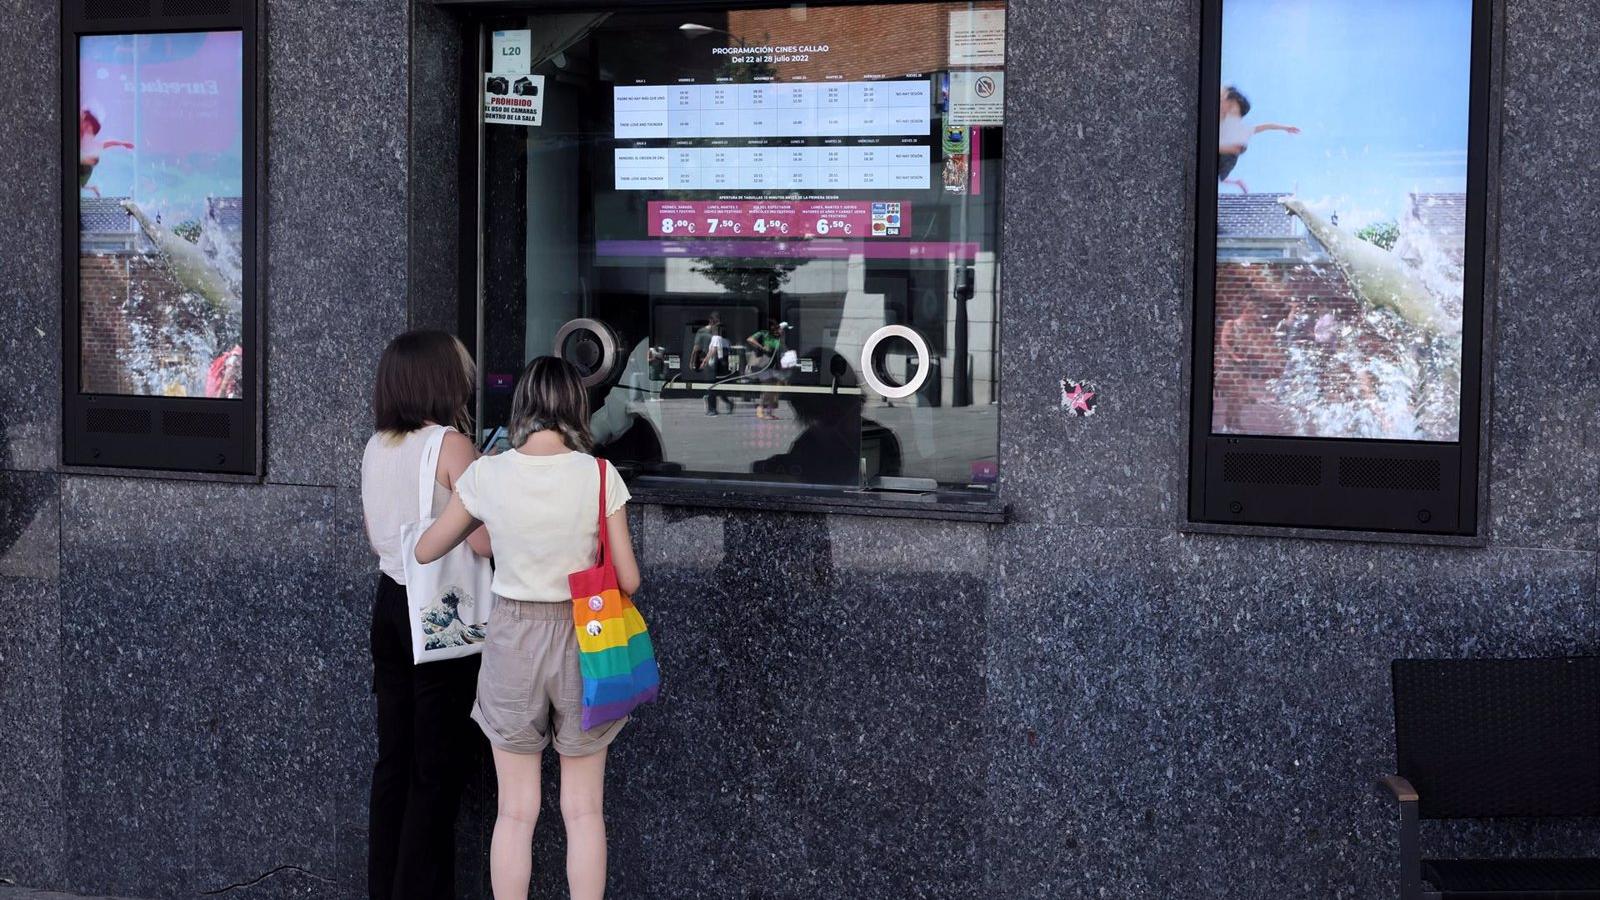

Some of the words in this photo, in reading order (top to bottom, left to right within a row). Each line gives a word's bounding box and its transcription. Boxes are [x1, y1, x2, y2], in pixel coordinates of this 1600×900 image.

[502, 46, 521, 56] L20
[712, 46, 773, 55] PROGRAMACIÓN
[774, 55, 790, 64] julio
[490, 97, 532, 107] PROHIBIDO
[522, 114, 536, 122] SALA
